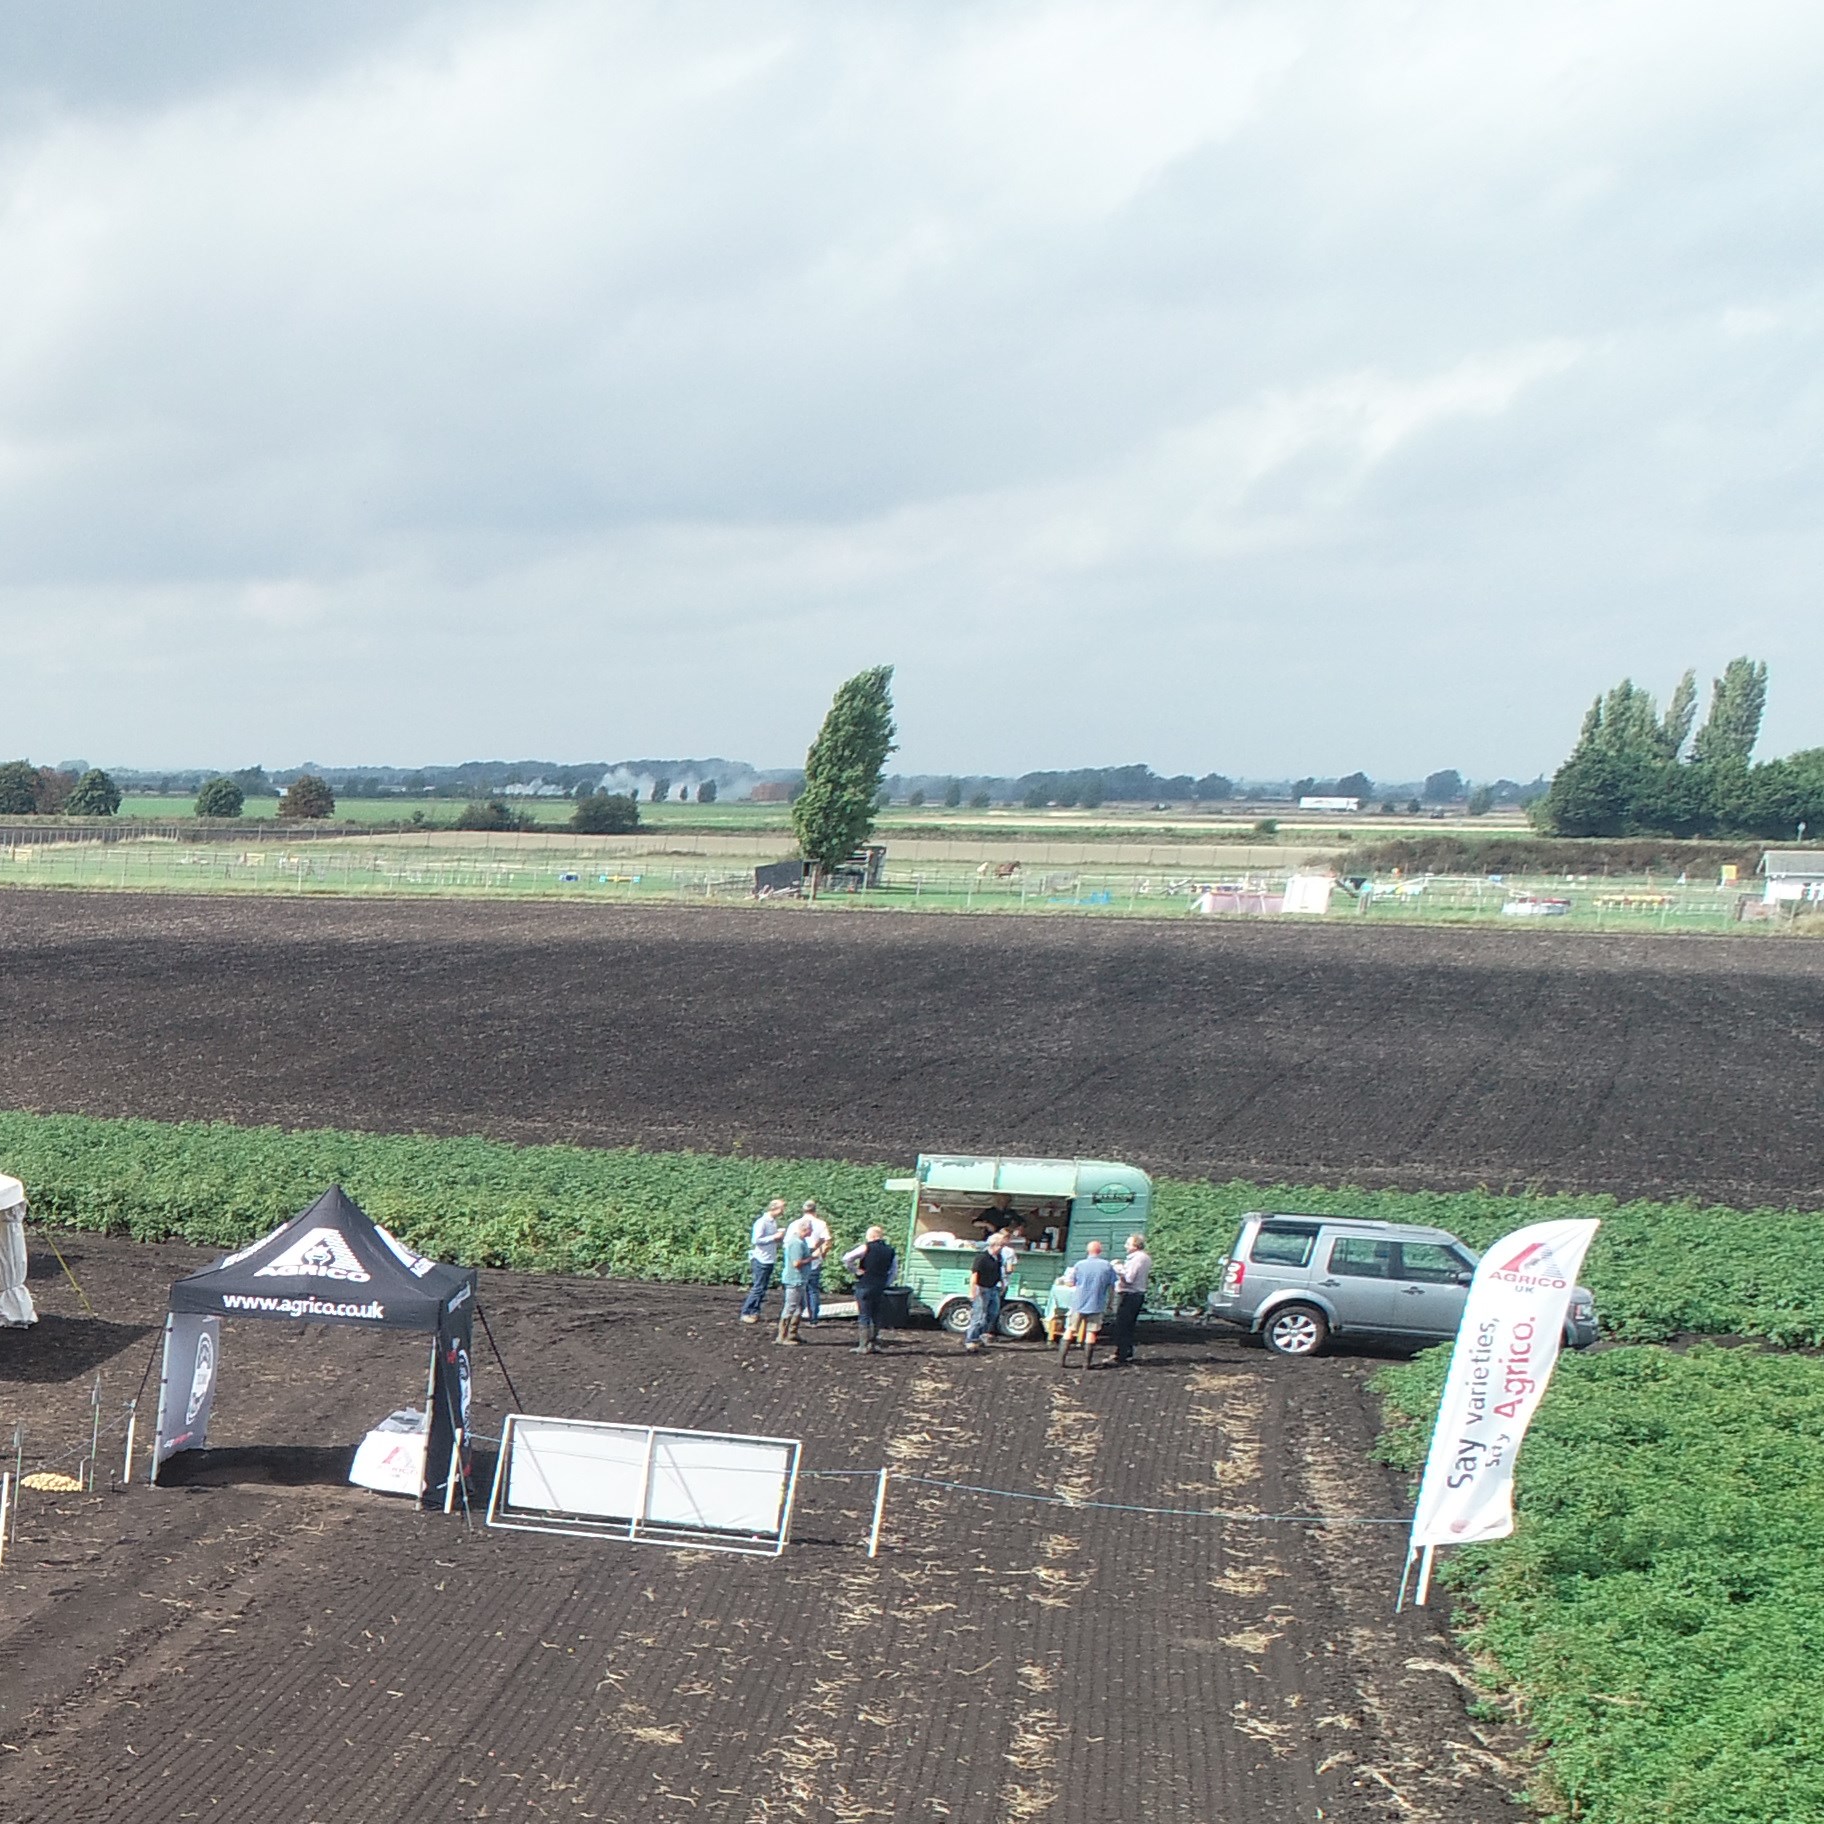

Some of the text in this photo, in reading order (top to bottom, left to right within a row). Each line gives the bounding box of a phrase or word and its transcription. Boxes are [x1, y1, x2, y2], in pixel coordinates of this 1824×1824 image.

[254, 1265, 371, 1283] AGRICO
[1488, 1271, 1568, 1290] AGRICO
[1514, 1285, 1536, 1294] UK
[222, 1294, 385, 1319] www.agrico.co.uk
[1493, 1316, 1536, 1419] Agrico.
[1446, 1317, 1501, 1490] Say varieties,
